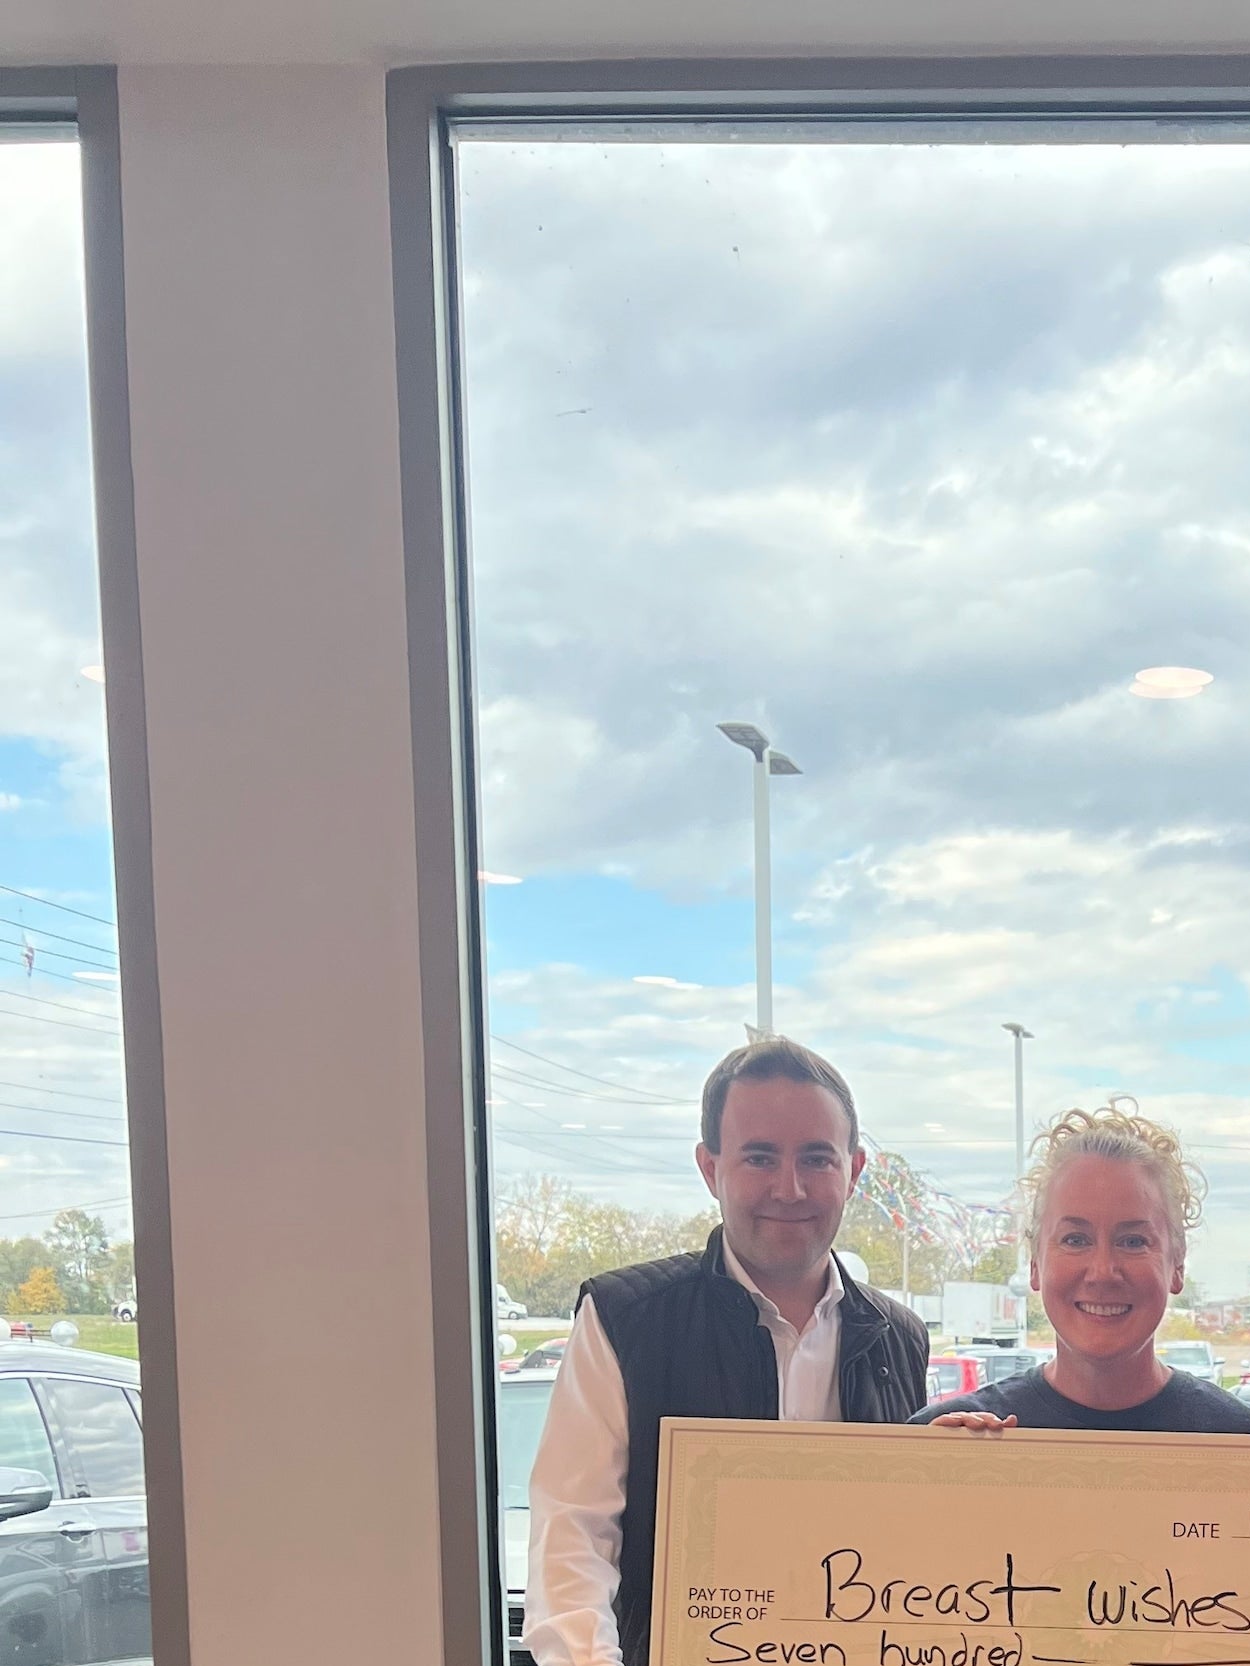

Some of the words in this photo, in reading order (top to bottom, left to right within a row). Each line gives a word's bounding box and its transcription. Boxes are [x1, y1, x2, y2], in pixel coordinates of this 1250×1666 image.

[1173, 1522, 1220, 1539] DATE
[688, 1587, 718, 1602] PAY
[721, 1588, 741, 1602] TO
[745, 1589, 775, 1604] THE
[821, 1548, 1062, 1626] Breast
[688, 1605, 743, 1620] ORDER
[746, 1607, 767, 1621] OF
